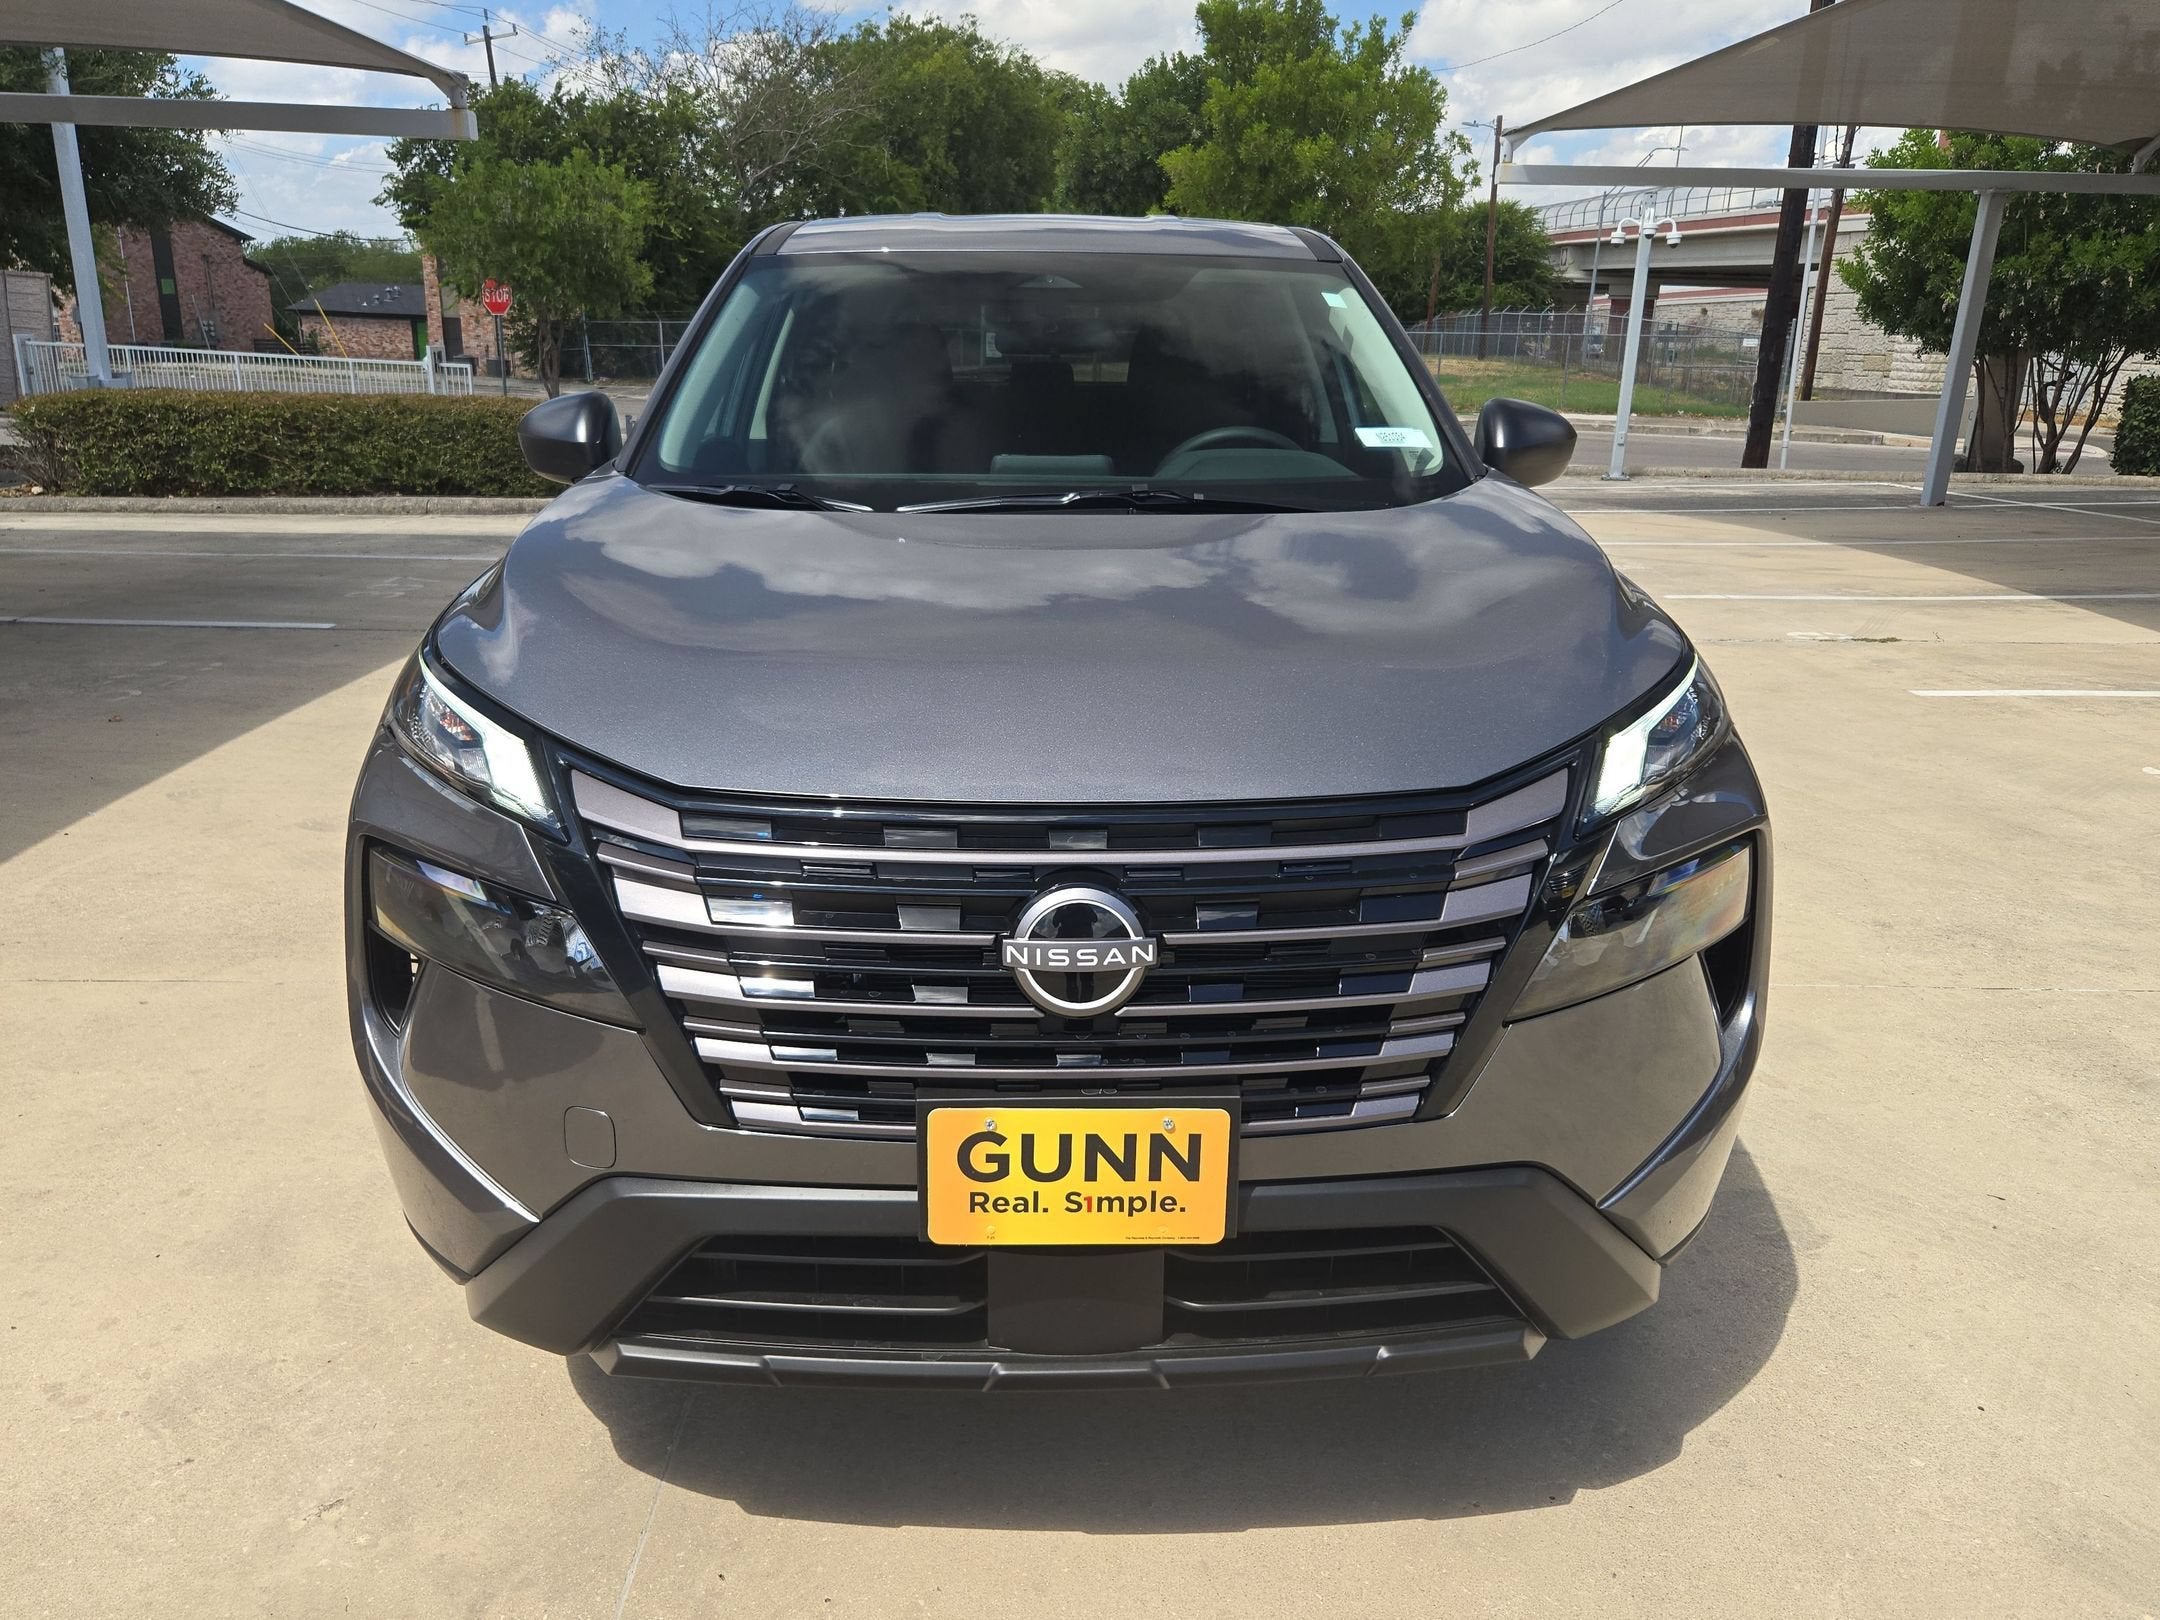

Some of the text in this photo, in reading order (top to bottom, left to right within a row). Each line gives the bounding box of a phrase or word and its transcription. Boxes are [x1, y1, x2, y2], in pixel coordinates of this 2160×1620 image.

[484, 287, 509, 303] STOP
[1006, 944, 1153, 967] NISSAN
[957, 1131, 1202, 1183] GUNN
[969, 1191, 1049, 1213] Real.
